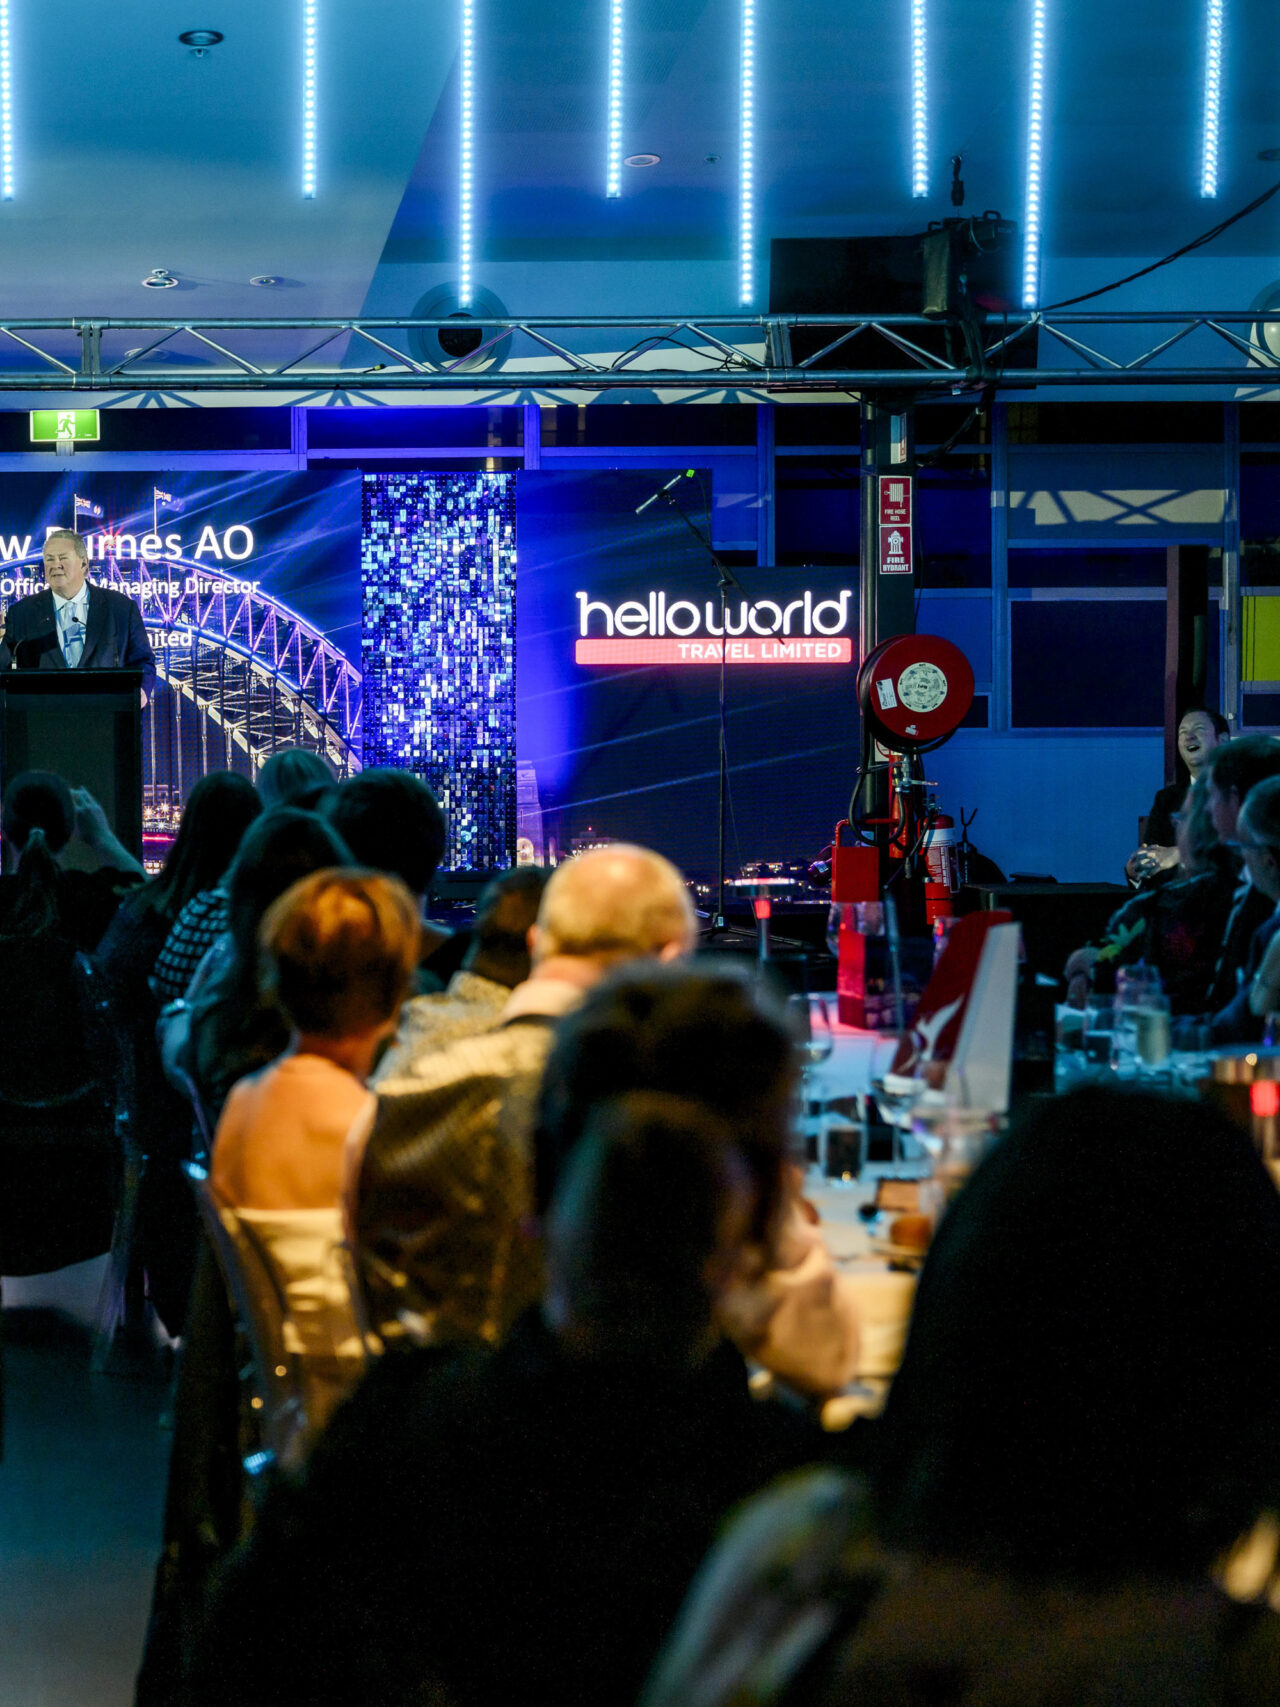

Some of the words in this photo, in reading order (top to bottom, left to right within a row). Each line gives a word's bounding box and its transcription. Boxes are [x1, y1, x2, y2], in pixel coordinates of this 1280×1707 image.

[45, 526, 182, 561] rnes
[194, 524, 255, 560] AO
[185, 576, 261, 595] Director
[575, 590, 852, 637] helloworld
[678, 642, 755, 659] TRAVEL
[761, 642, 842, 659] LIMITED
